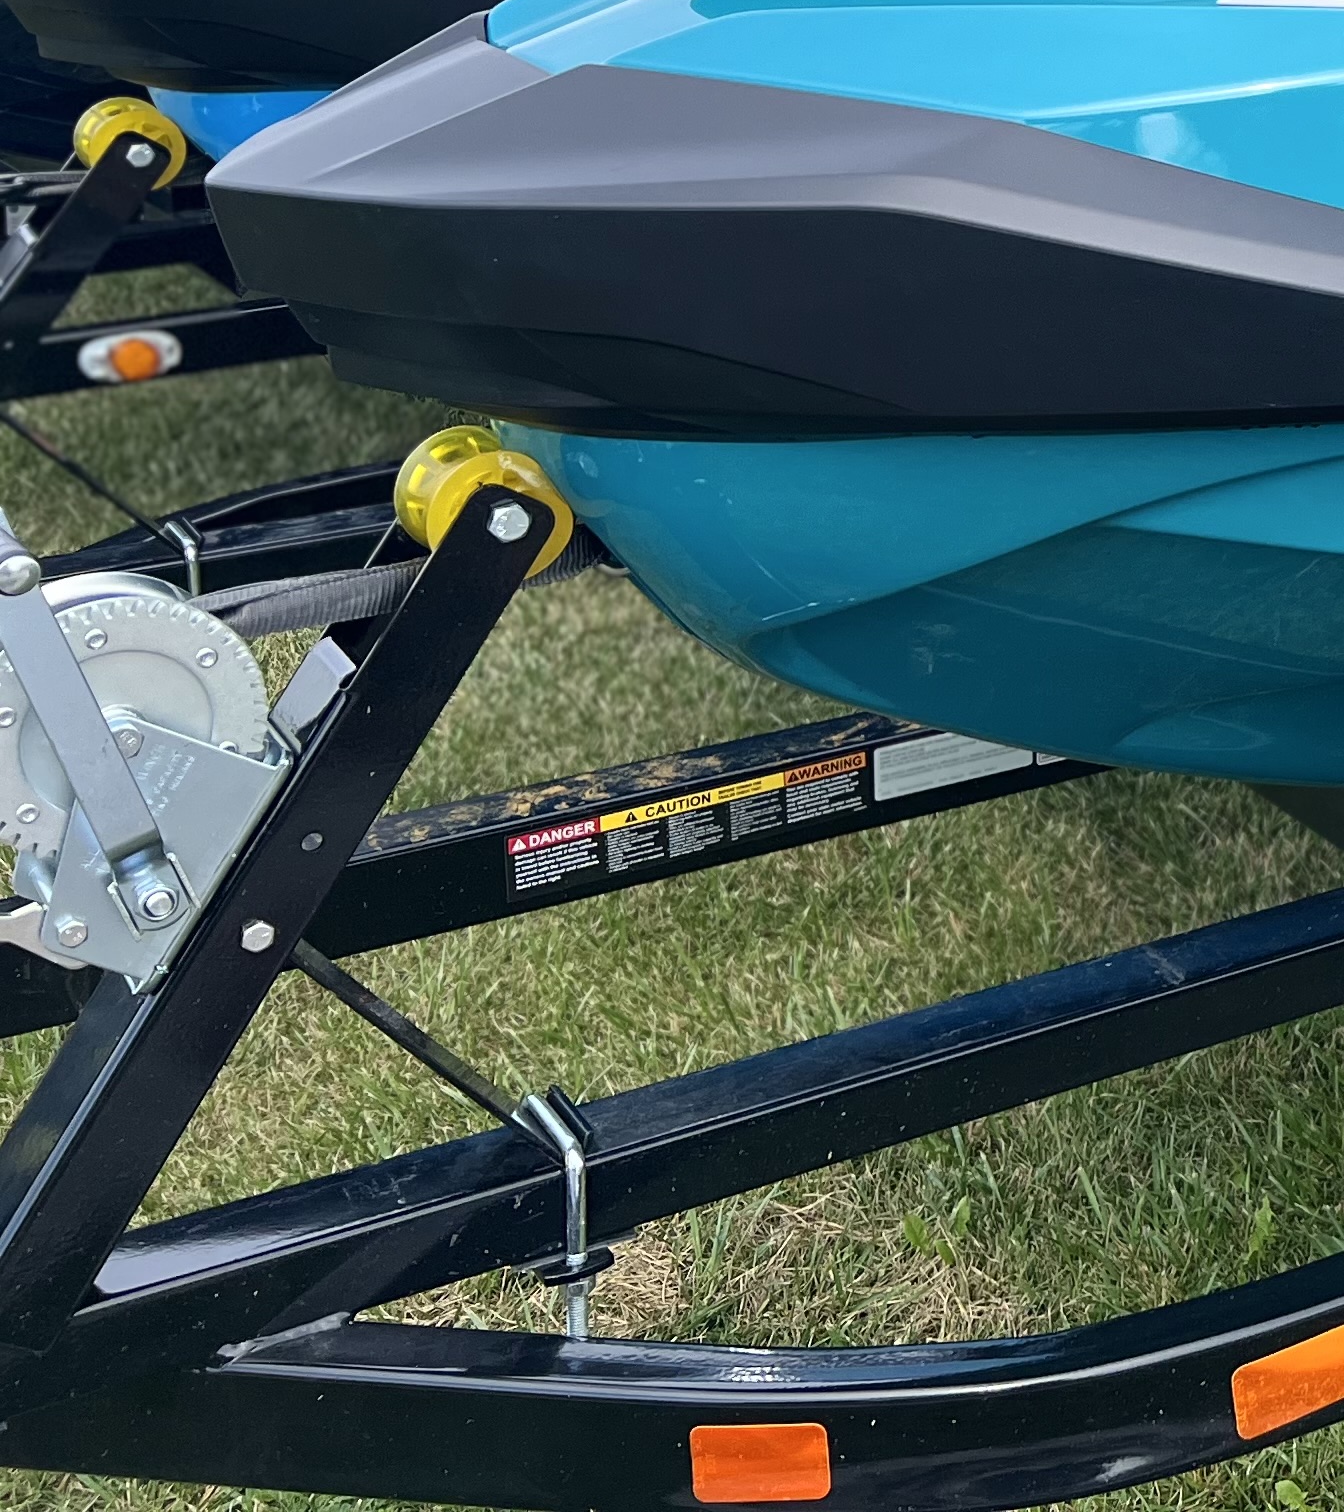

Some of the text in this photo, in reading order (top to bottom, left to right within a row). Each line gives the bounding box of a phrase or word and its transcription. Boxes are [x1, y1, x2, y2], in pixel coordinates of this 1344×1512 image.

[798, 755, 862, 780] WARNING
[645, 792, 711, 818] CAUTION
[529, 820, 595, 847] DANGER
